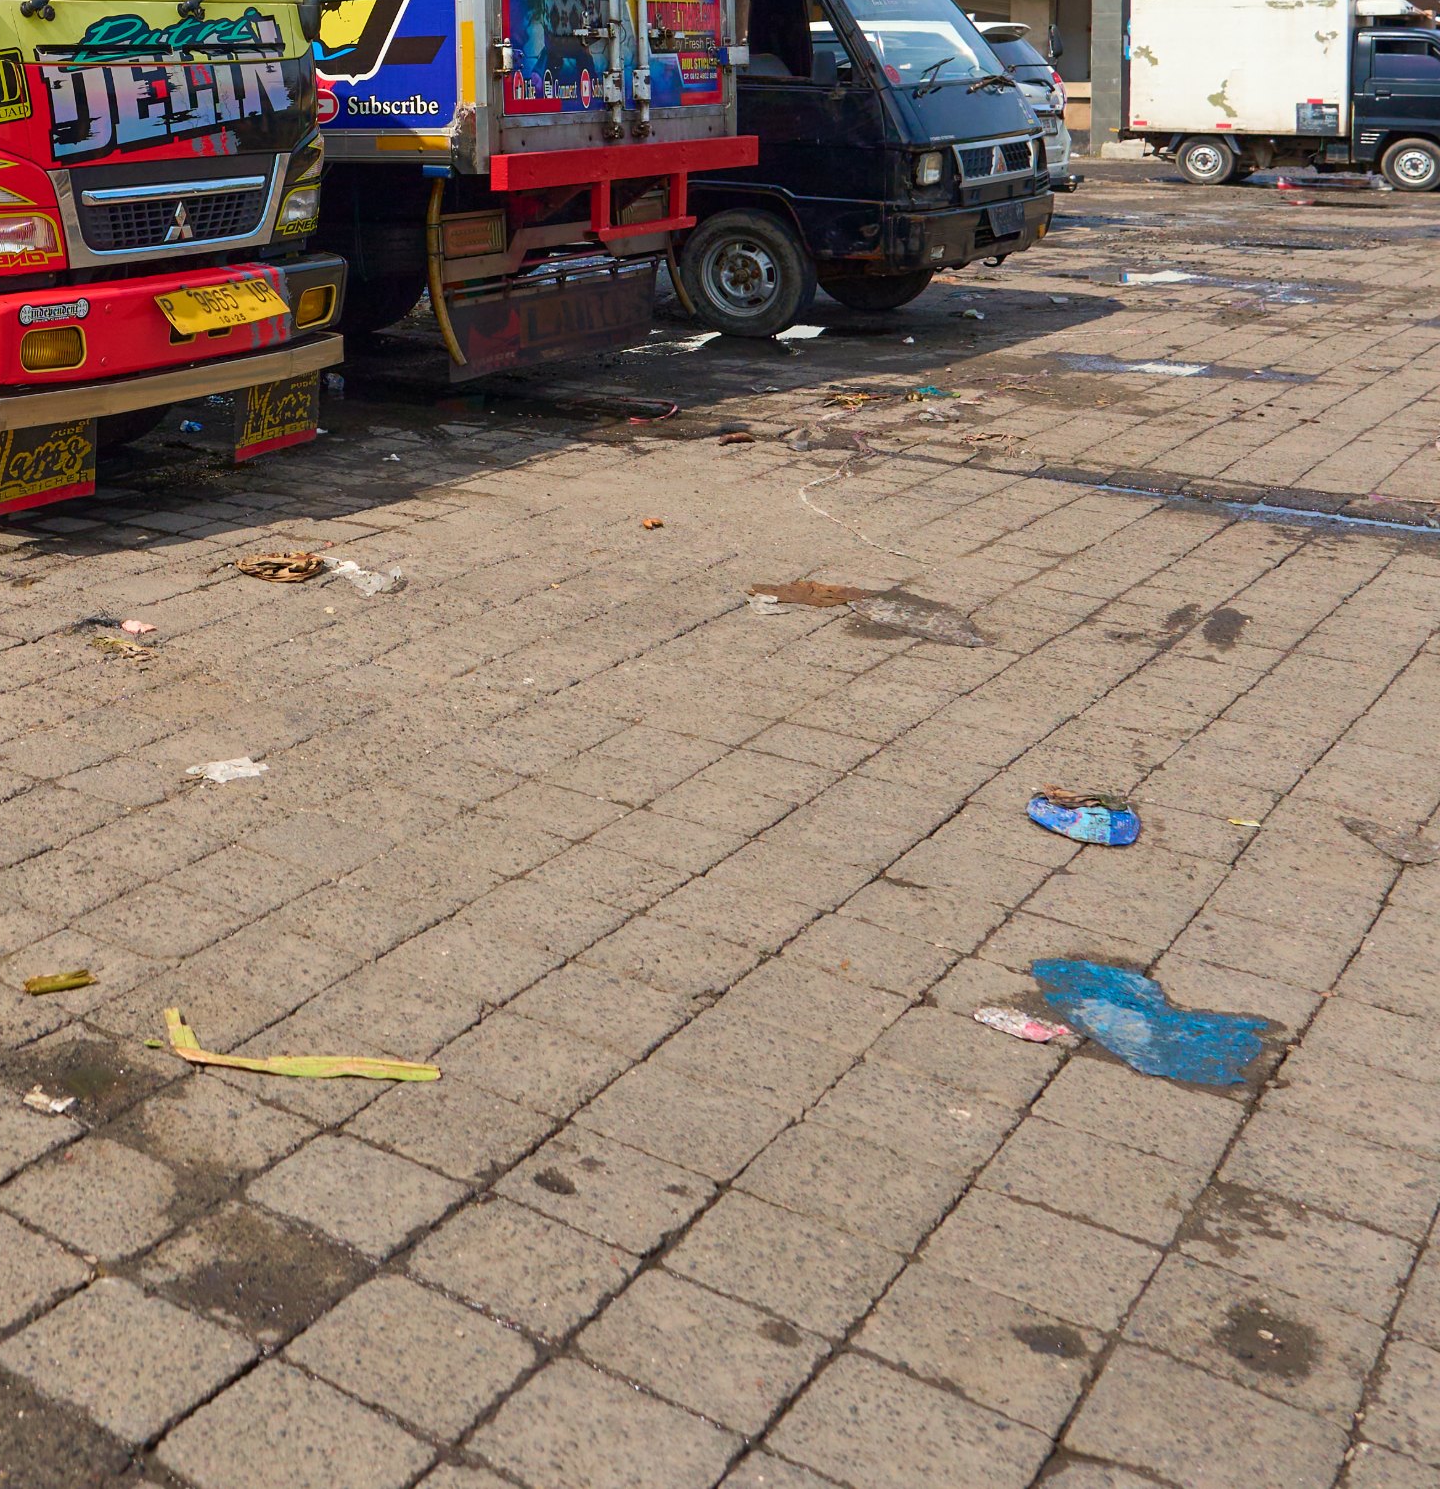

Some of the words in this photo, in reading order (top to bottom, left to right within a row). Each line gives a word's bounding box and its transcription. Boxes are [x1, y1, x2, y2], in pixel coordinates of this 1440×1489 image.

[68, 8, 258, 70] Putri
[684, 37, 704, 49] Fresh
[554, 78, 578, 99] Comment
[347, 94, 439, 115] Subscribe
[160, 298, 176, 322] P
[194, 287, 239, 314] 9665
[245, 280, 279, 303] UR
